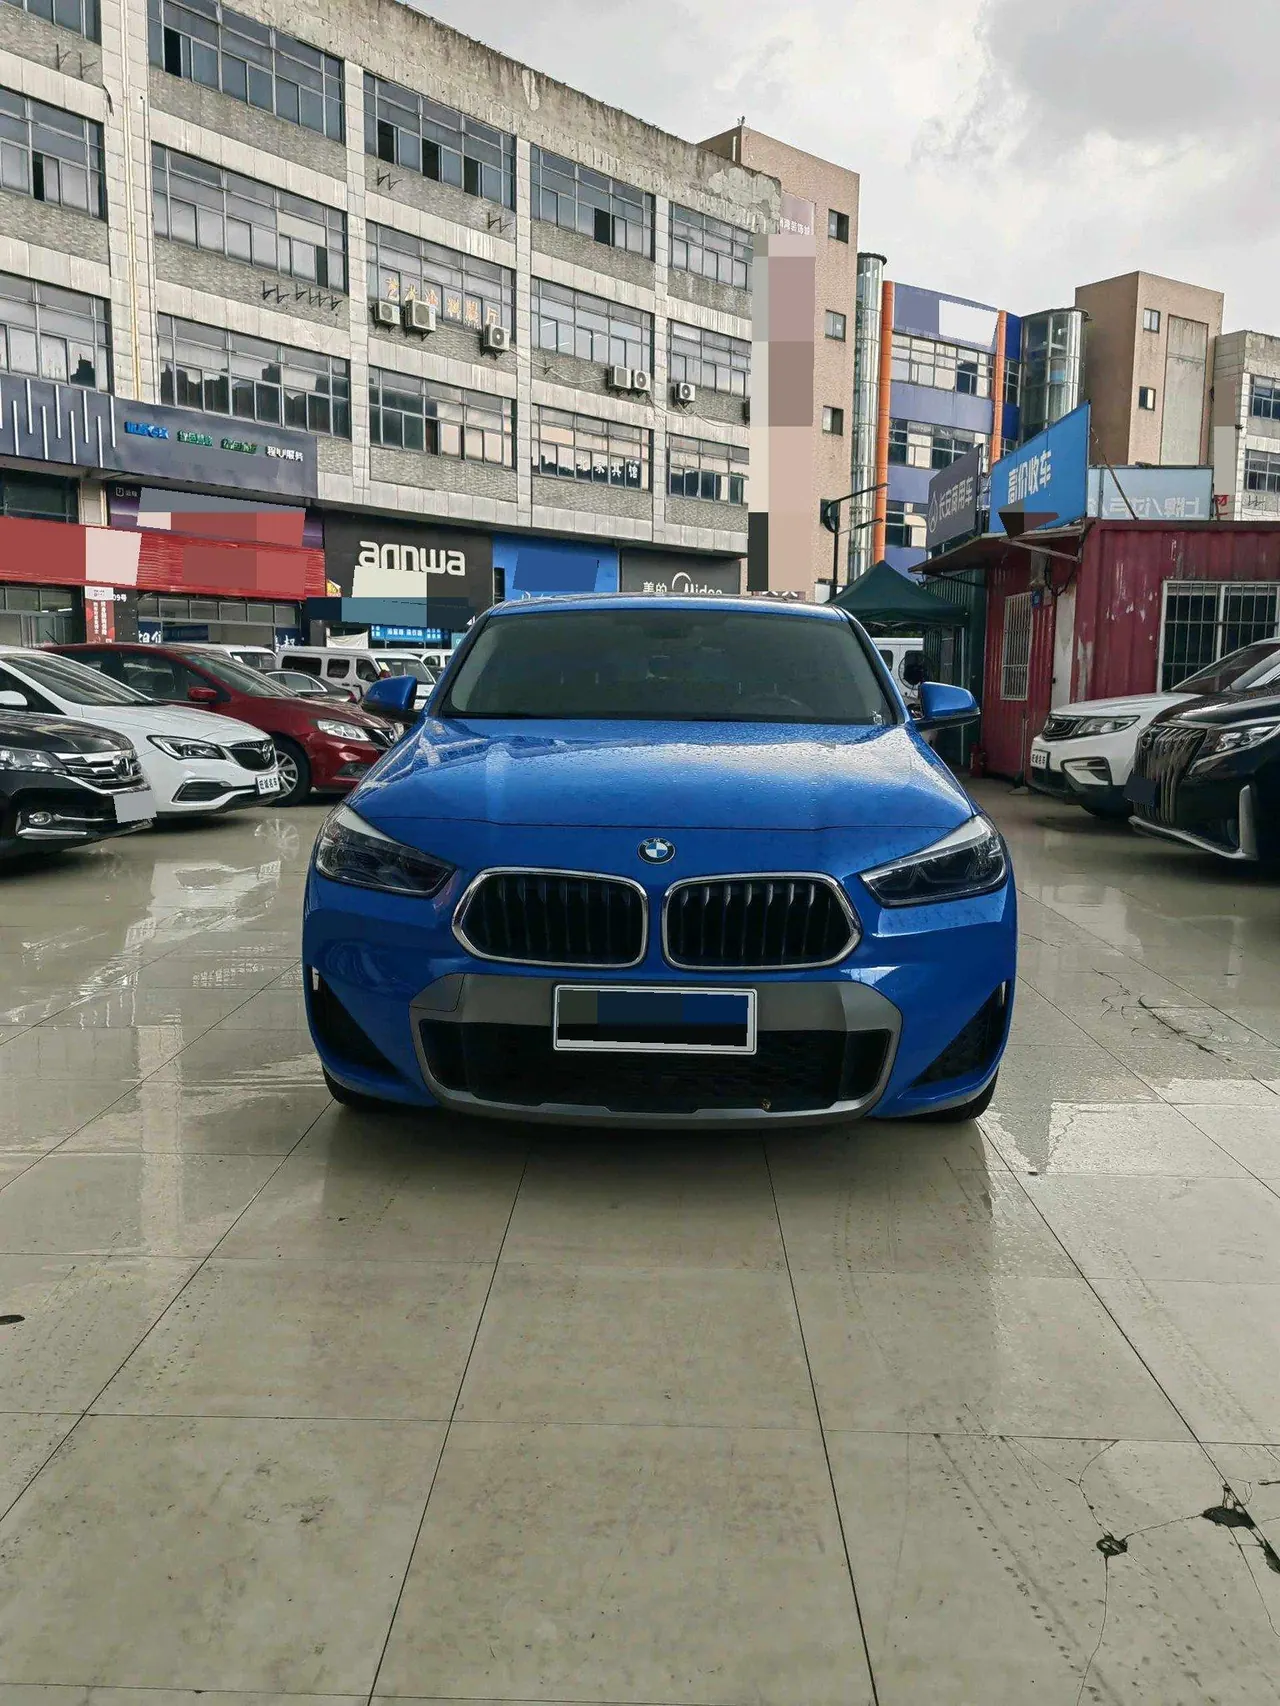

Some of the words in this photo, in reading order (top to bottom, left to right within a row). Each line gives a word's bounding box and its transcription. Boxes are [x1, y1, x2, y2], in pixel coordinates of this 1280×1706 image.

[1008, 449, 1052, 504] 高价收车
[359, 540, 466, 576] annwa
